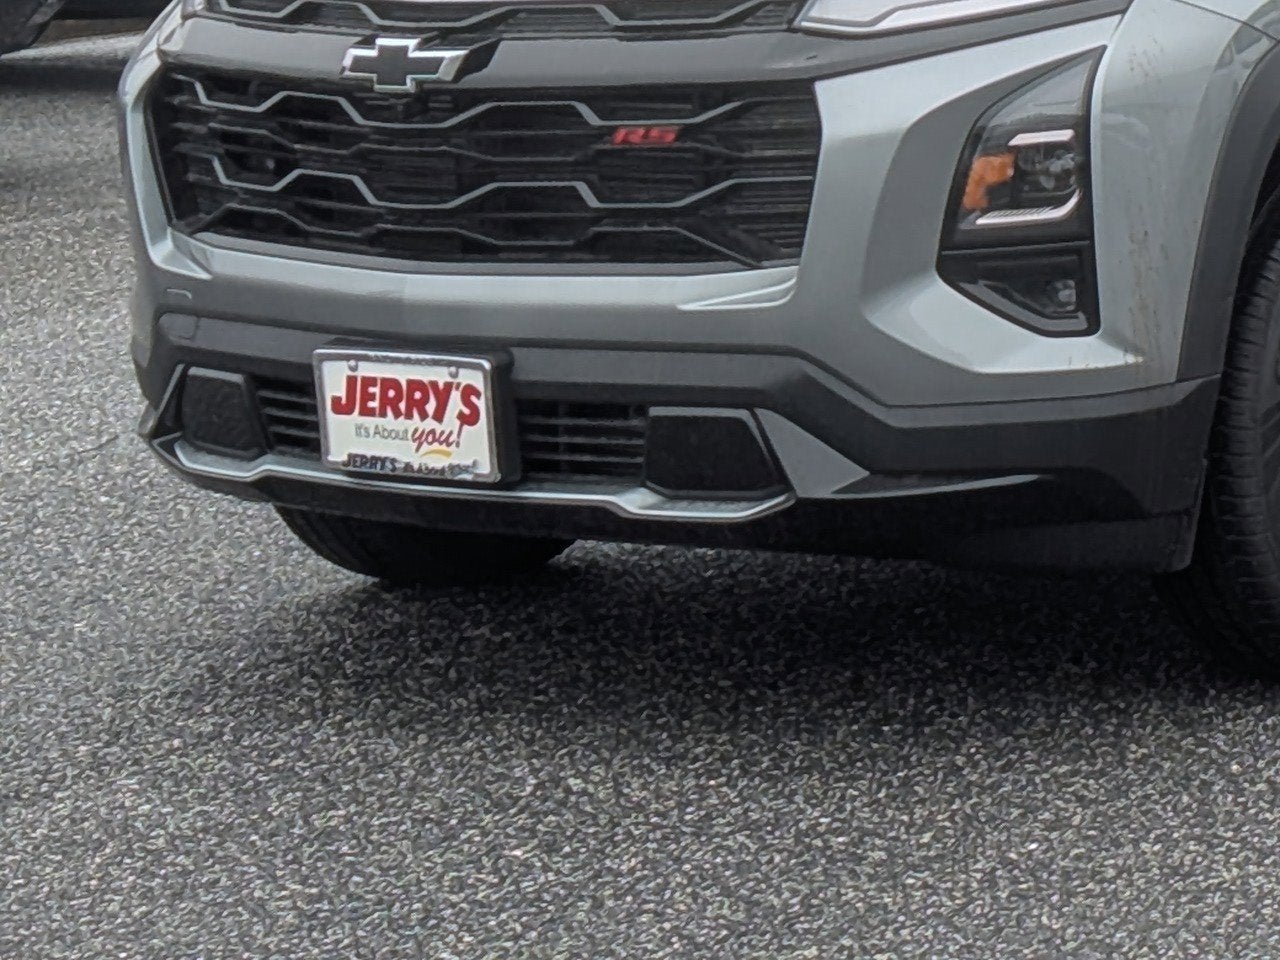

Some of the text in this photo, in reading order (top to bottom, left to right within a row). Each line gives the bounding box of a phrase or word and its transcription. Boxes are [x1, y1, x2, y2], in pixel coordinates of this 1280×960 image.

[330, 374, 482, 427] JERRY'S
[354, 422, 464, 454] It's About you!
